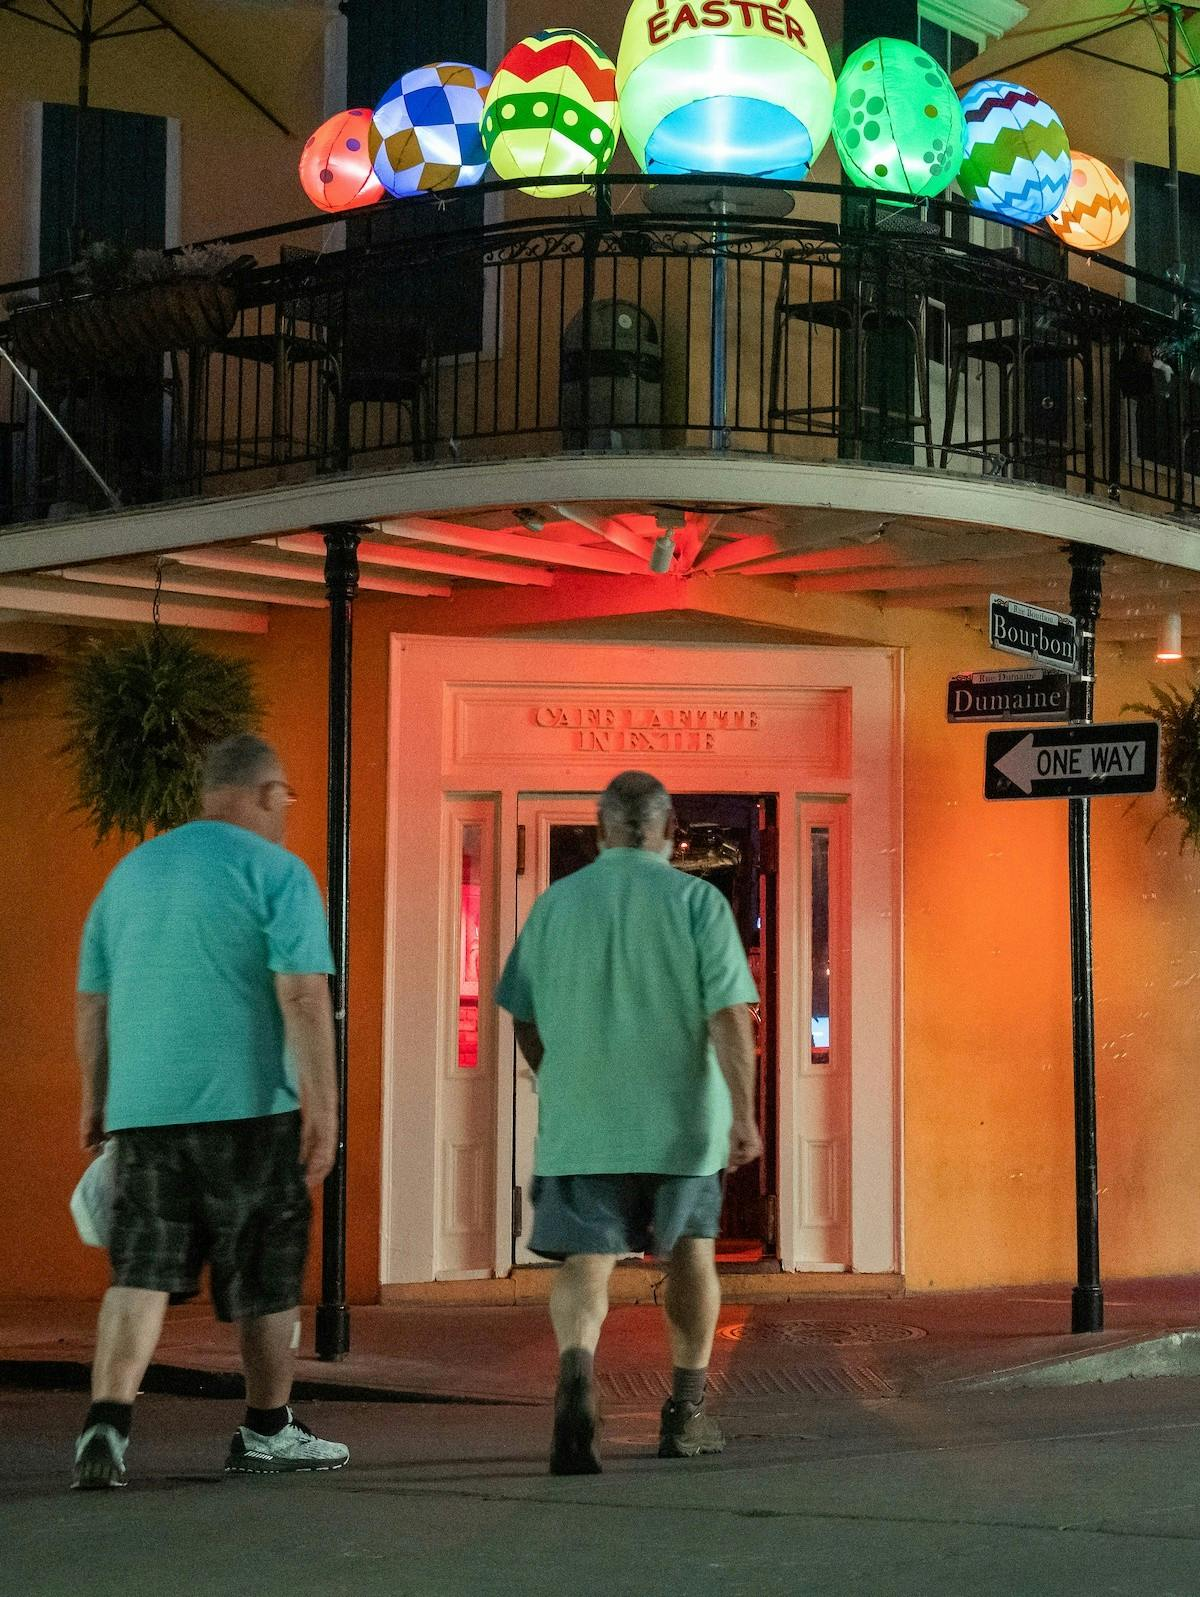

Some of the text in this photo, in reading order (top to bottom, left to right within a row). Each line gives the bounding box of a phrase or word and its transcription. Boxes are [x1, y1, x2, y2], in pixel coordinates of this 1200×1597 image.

[648, 0, 806, 46] EASTER
[993, 613, 1072, 657] Bourbon
[954, 685, 1061, 712] Dumaine
[1037, 745, 1139, 776] ONE WAY
